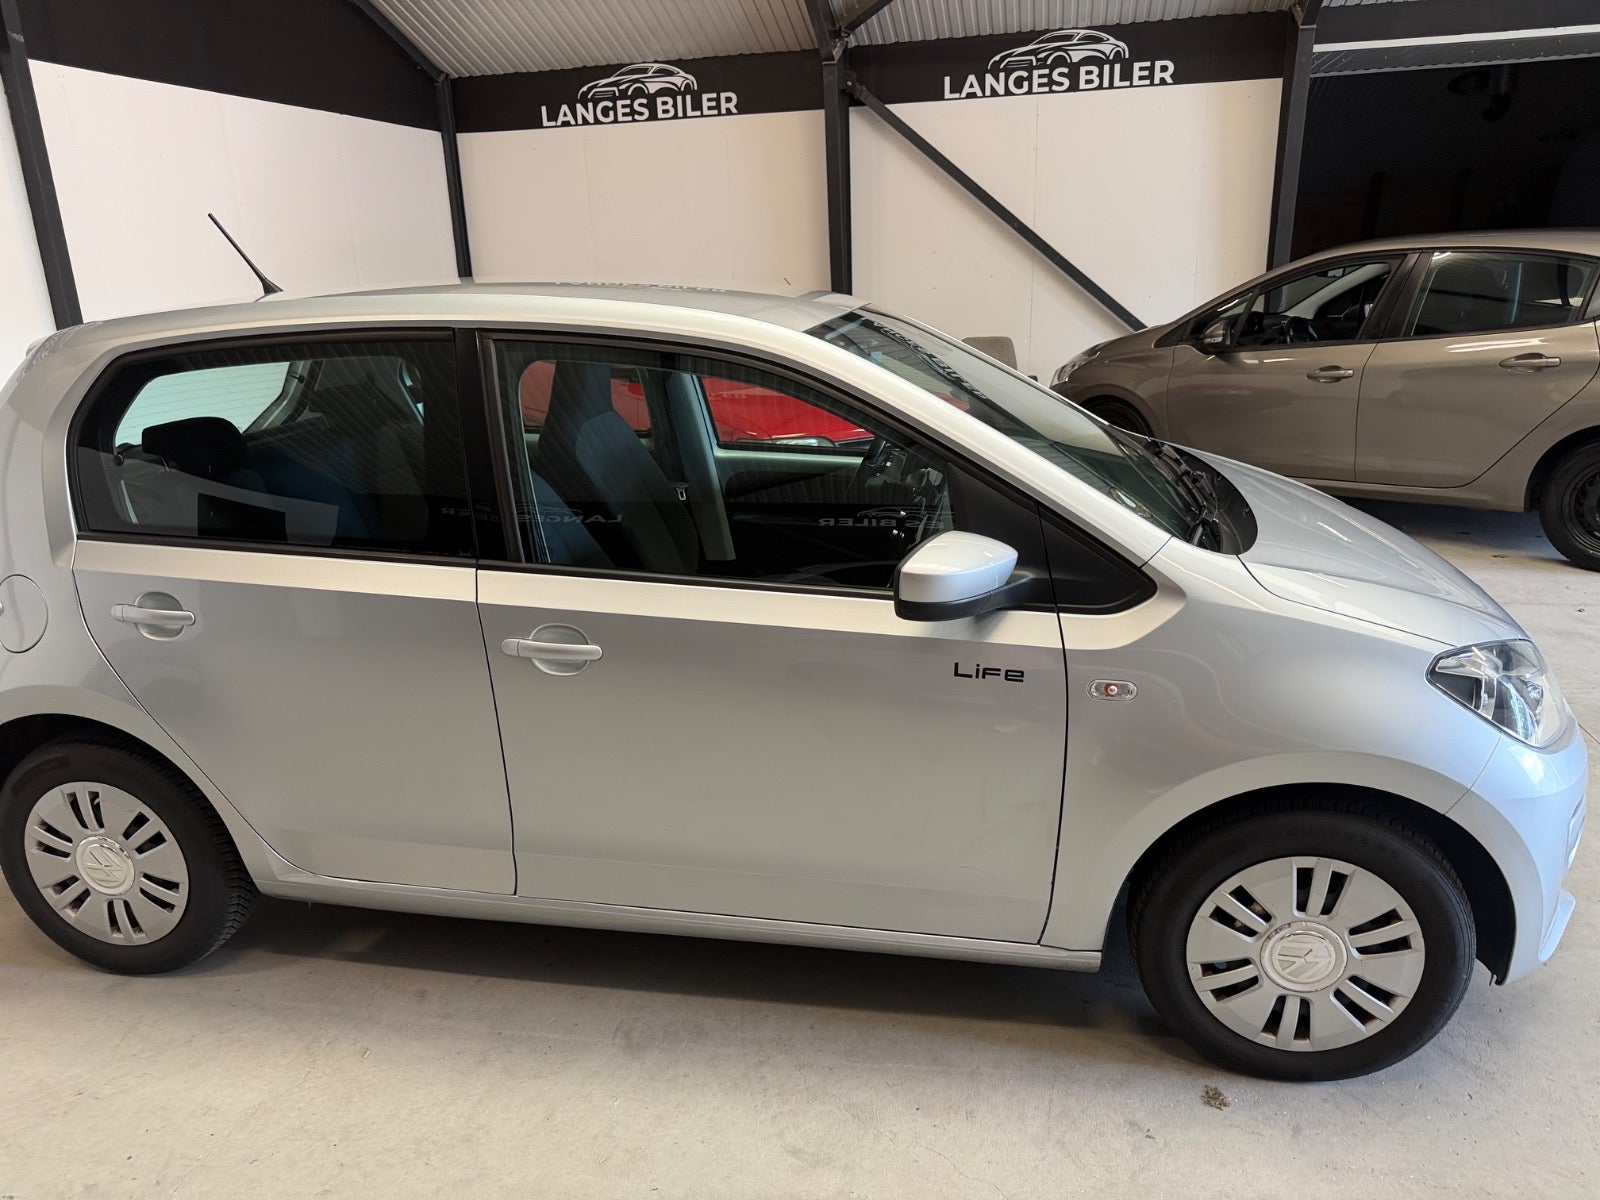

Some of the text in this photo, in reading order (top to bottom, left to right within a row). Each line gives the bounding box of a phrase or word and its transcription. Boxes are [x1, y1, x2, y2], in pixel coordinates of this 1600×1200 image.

[943, 60, 1175, 99] LANGES BILER
[541, 91, 738, 127] LANGES BILER
